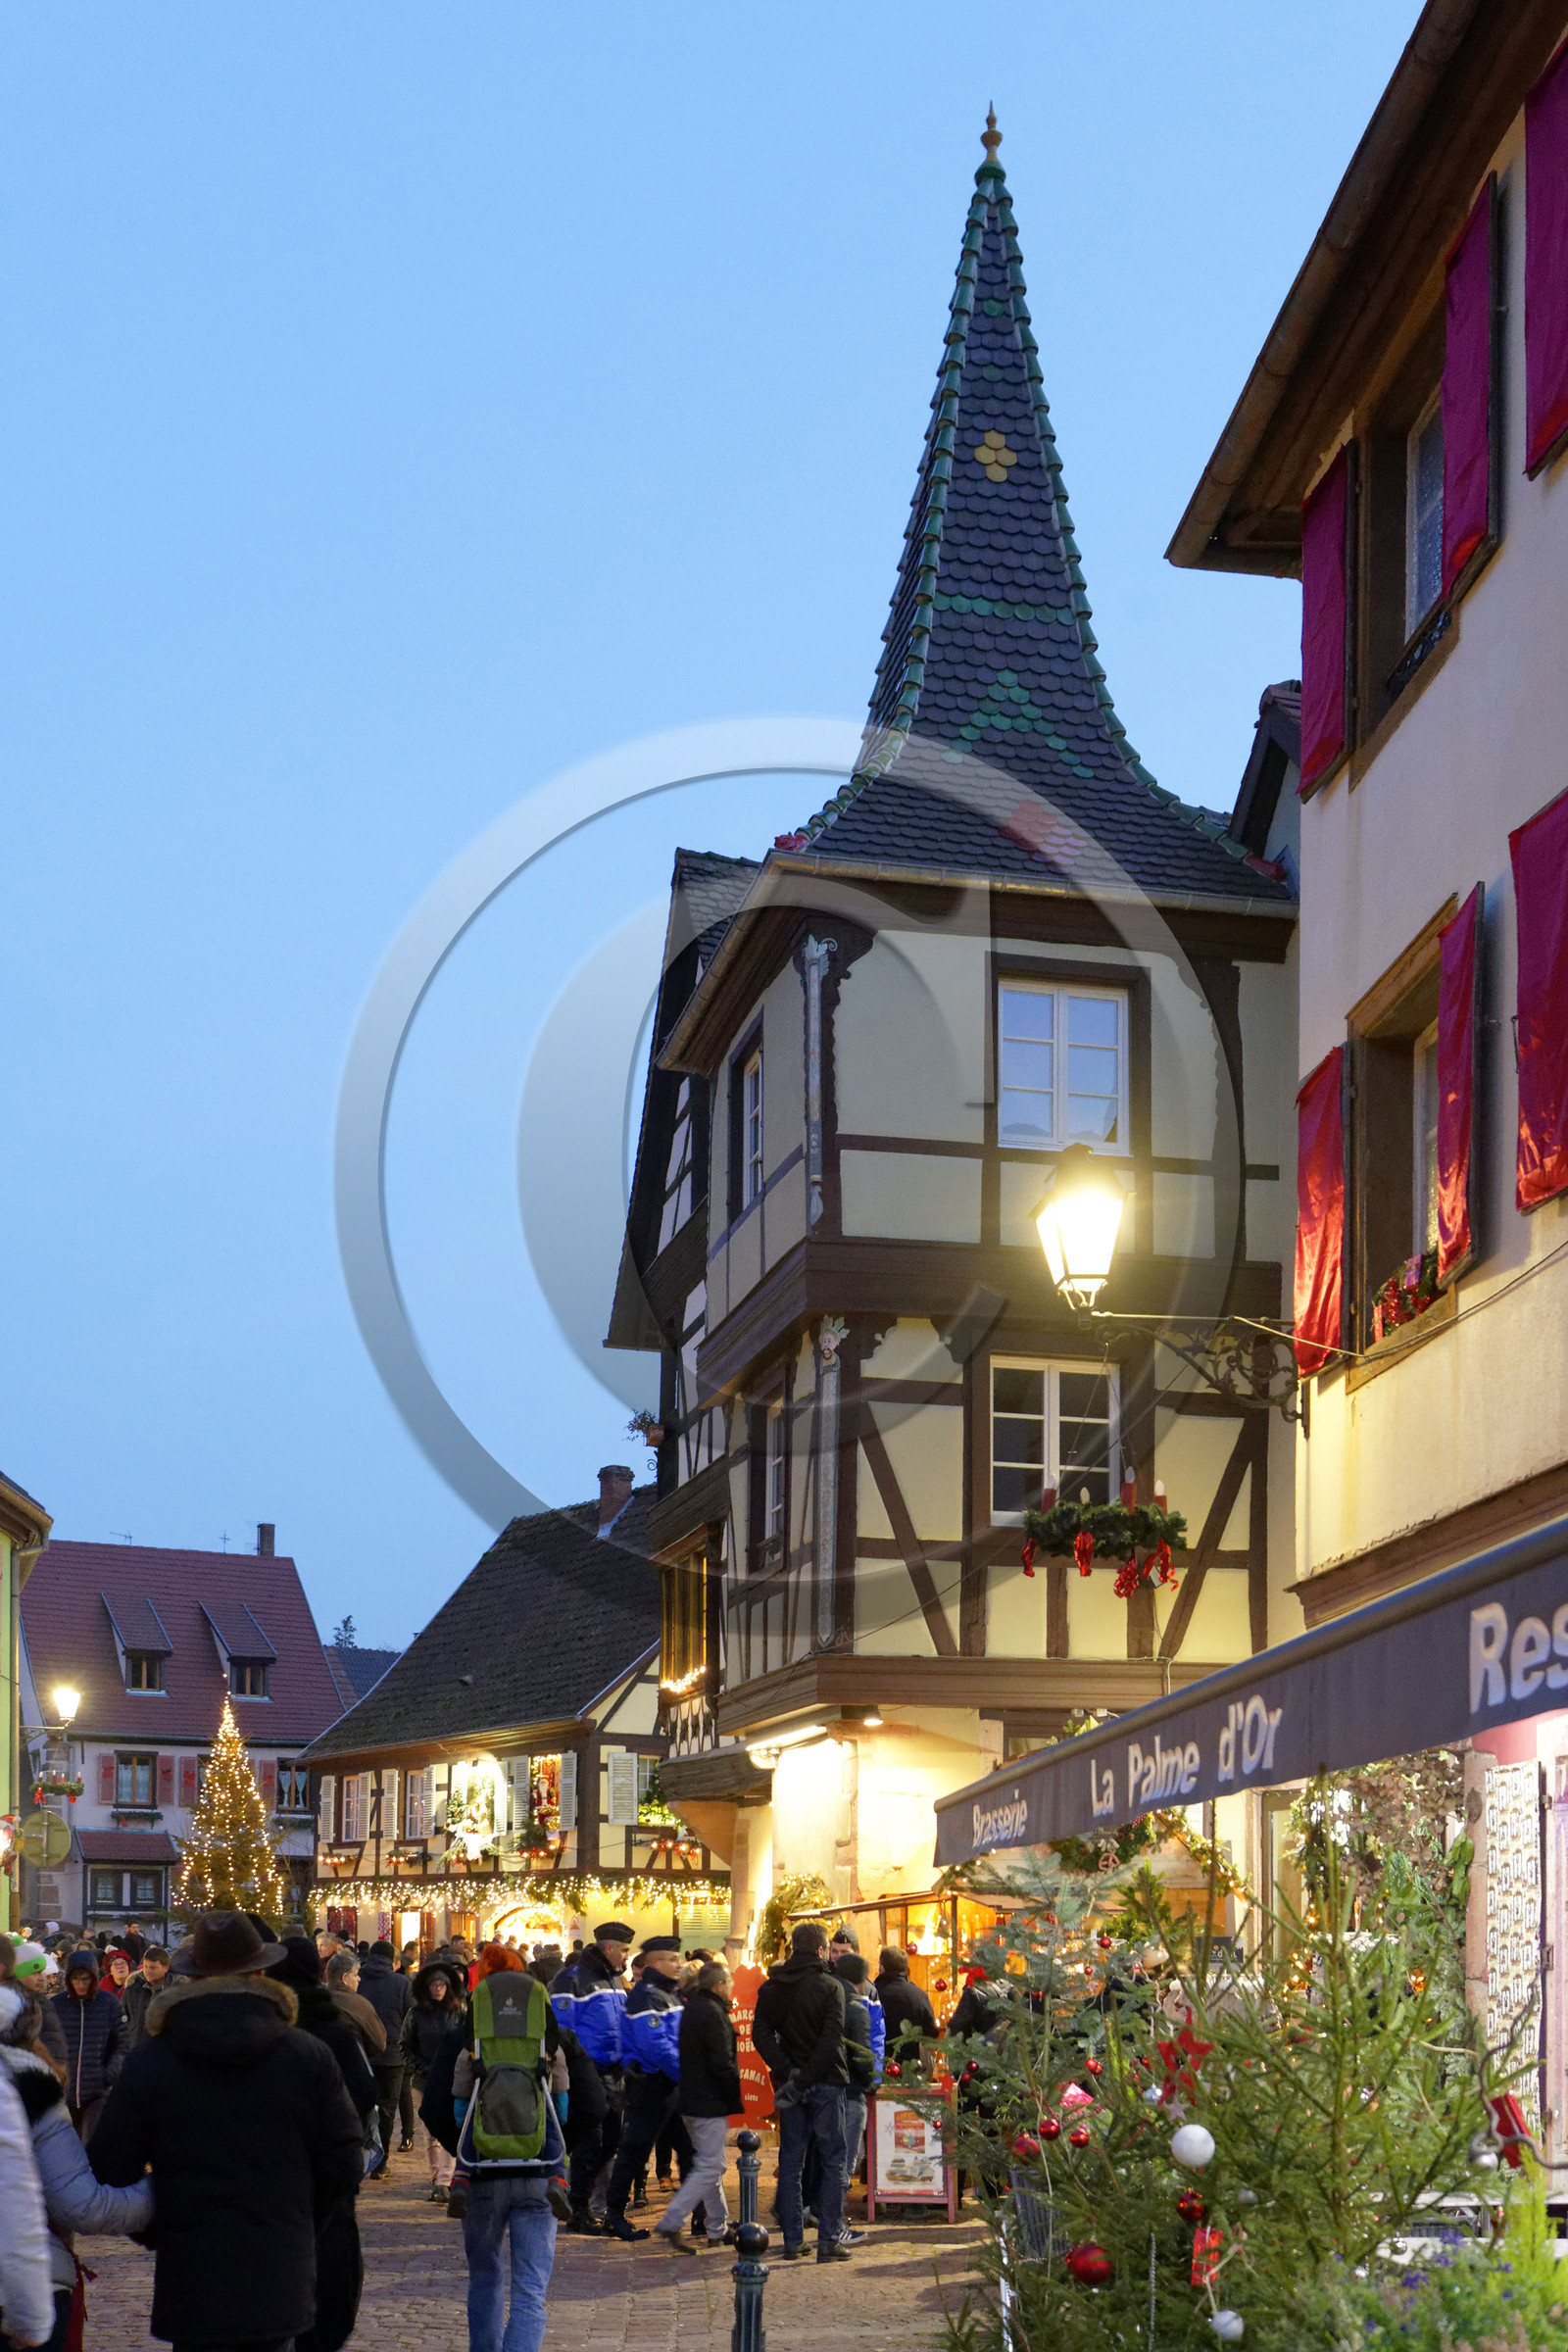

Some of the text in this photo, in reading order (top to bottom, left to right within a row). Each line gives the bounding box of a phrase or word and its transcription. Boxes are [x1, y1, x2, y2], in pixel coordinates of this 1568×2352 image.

[972, 1788, 1028, 1848] Brasserie
[1091, 1759, 1114, 1818] La
[1128, 1735, 1200, 1809] Palme
[1218, 1693, 1283, 1783] d'Or
[728, 2009, 755, 2024] MARC
[739, 2024, 752, 2035] DE
